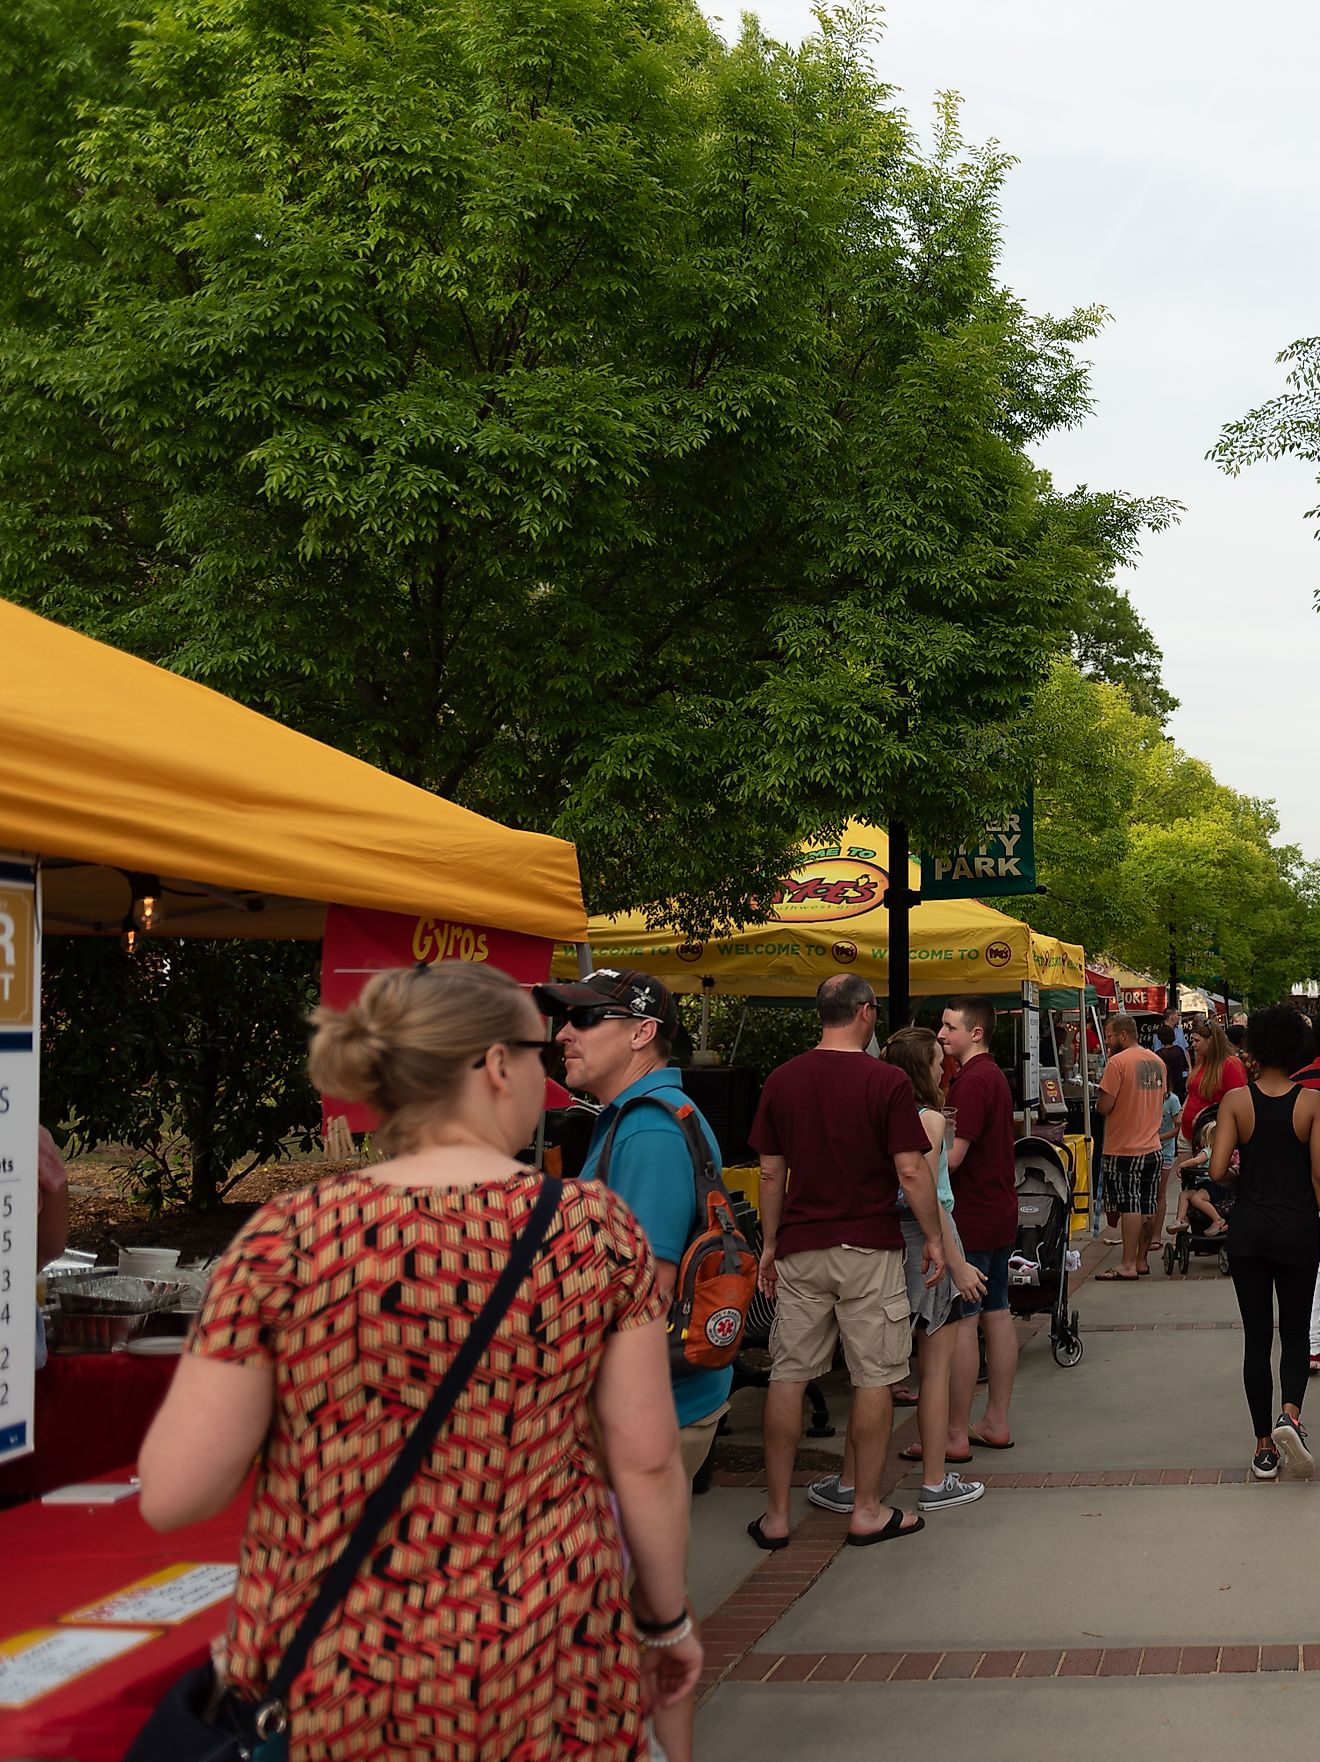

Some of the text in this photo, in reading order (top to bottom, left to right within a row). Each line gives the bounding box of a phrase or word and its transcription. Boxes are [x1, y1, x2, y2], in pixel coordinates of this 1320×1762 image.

[848, 846, 876, 859] TO
[935, 857, 1022, 880] PARK
[412, 917, 489, 967] Gyros
[651, 946, 671, 956] TO
[717, 944, 800, 956] WELCOME
[806, 945, 826, 956] TO
[959, 949, 979, 960] TO
